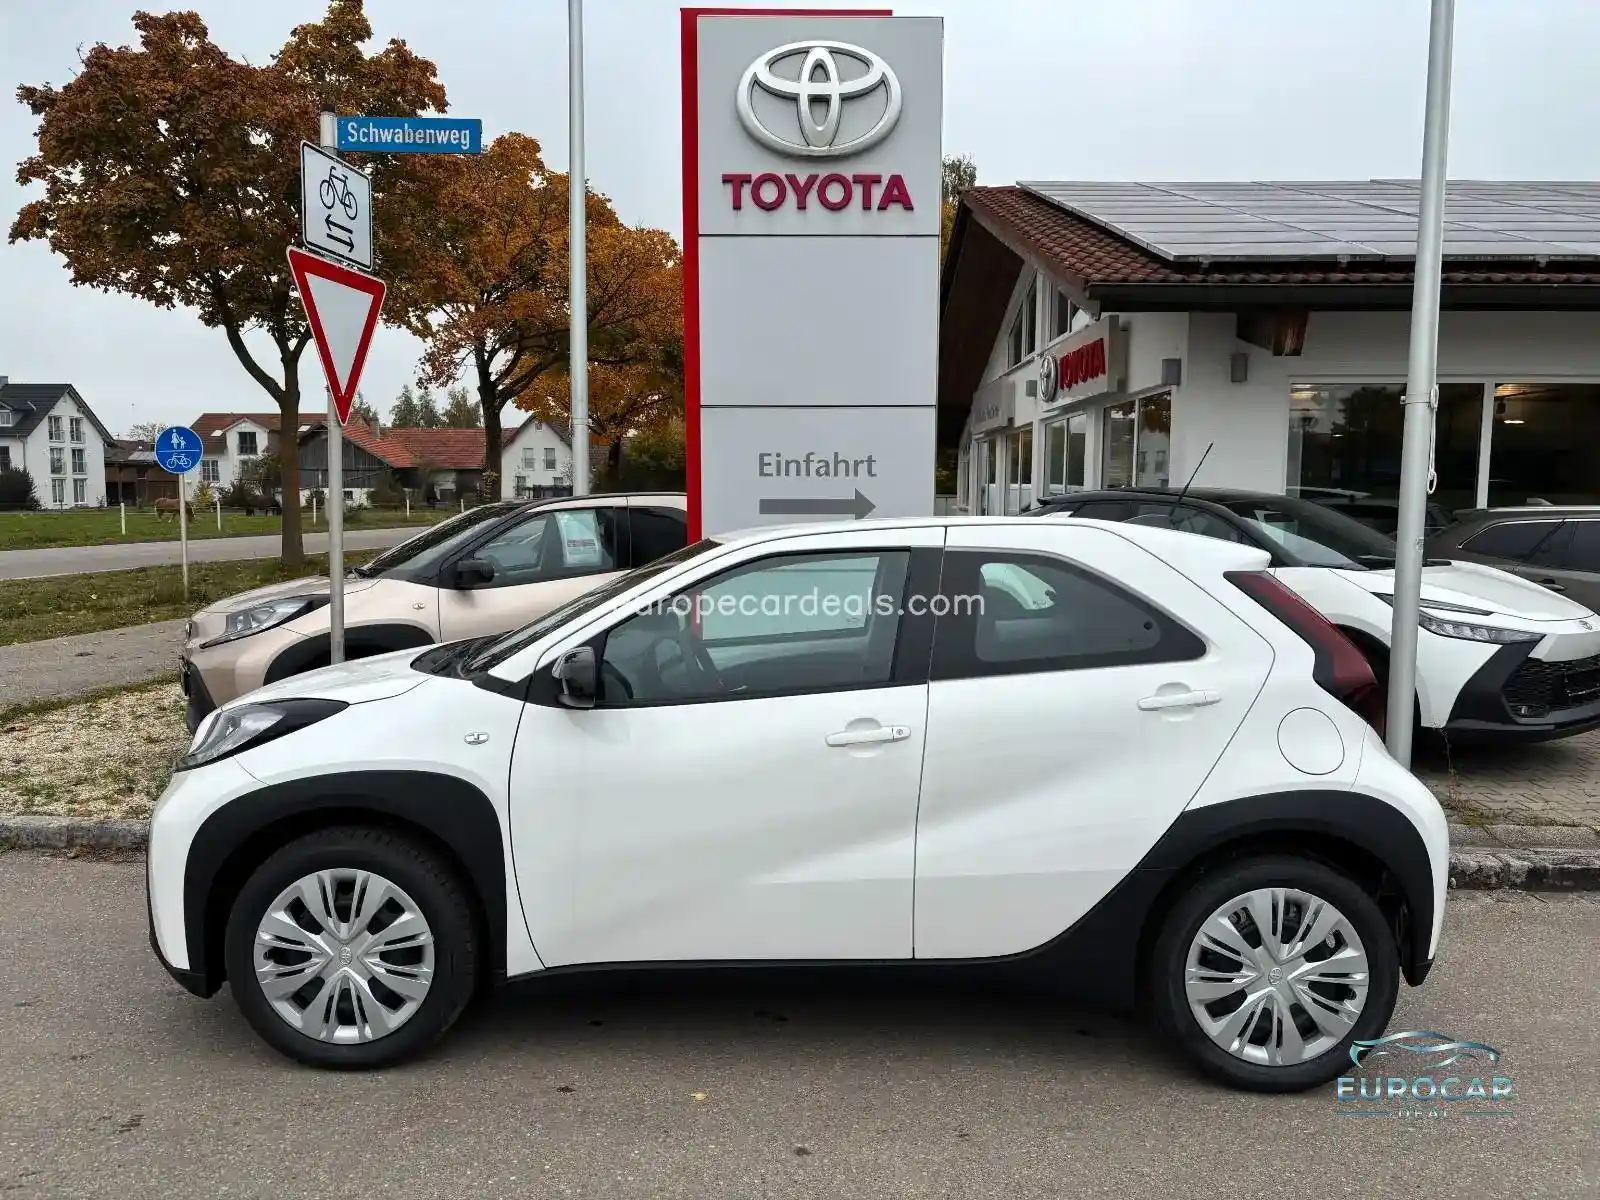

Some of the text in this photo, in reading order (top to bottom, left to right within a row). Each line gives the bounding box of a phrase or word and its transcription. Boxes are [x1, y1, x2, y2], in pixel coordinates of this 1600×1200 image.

[347, 122, 470, 150] Schwabenweg
[721, 173, 914, 211] TOYOTA
[1058, 337, 1106, 392] TOYOTA
[758, 451, 878, 477] Einfahrt
